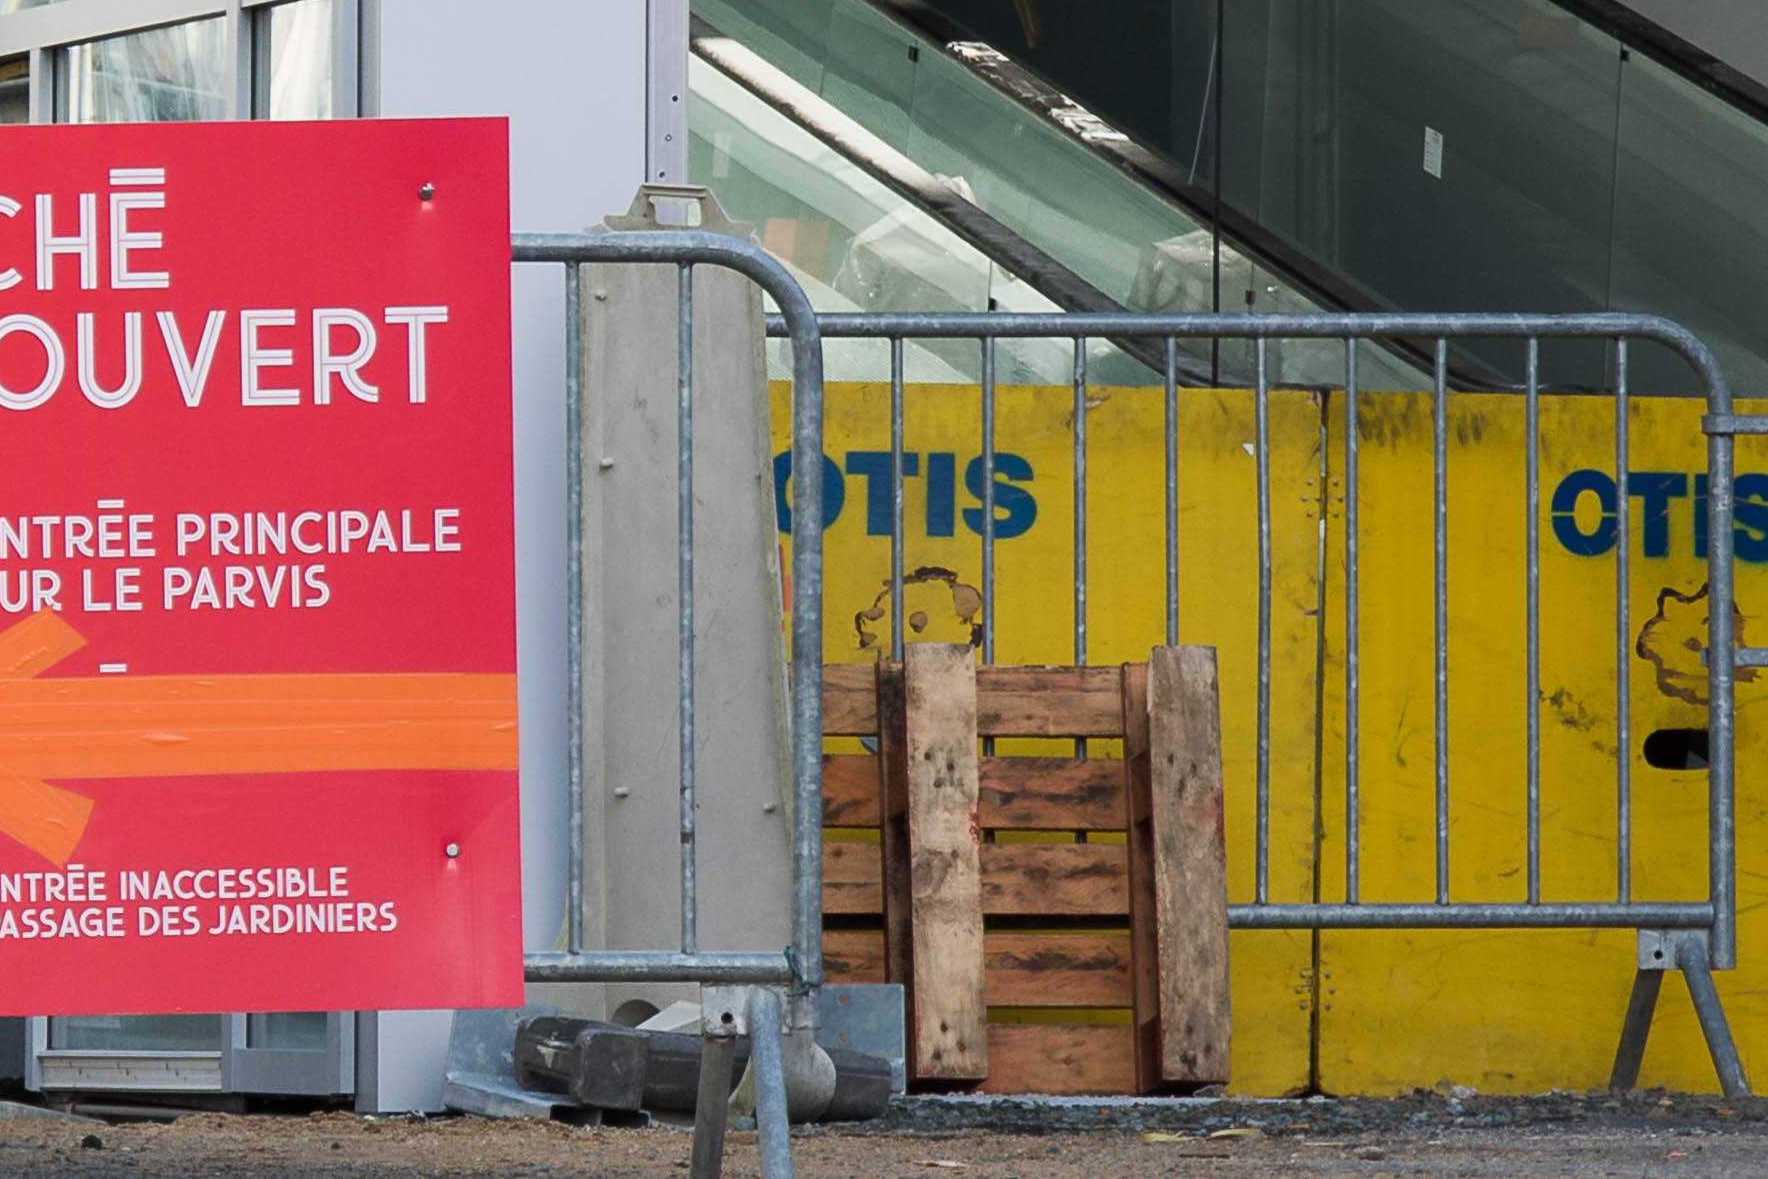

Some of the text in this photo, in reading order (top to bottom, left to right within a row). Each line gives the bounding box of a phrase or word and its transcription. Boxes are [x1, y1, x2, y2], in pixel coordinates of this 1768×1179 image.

[177, 508, 462, 555] PRINCIPALE
[83, 567, 143, 612] LE
[163, 564, 331, 610] PARVIS
[120, 866, 350, 900] INACCESSIBLE
[138, 905, 201, 937] DES
[209, 902, 399, 935] JARDINIERS
